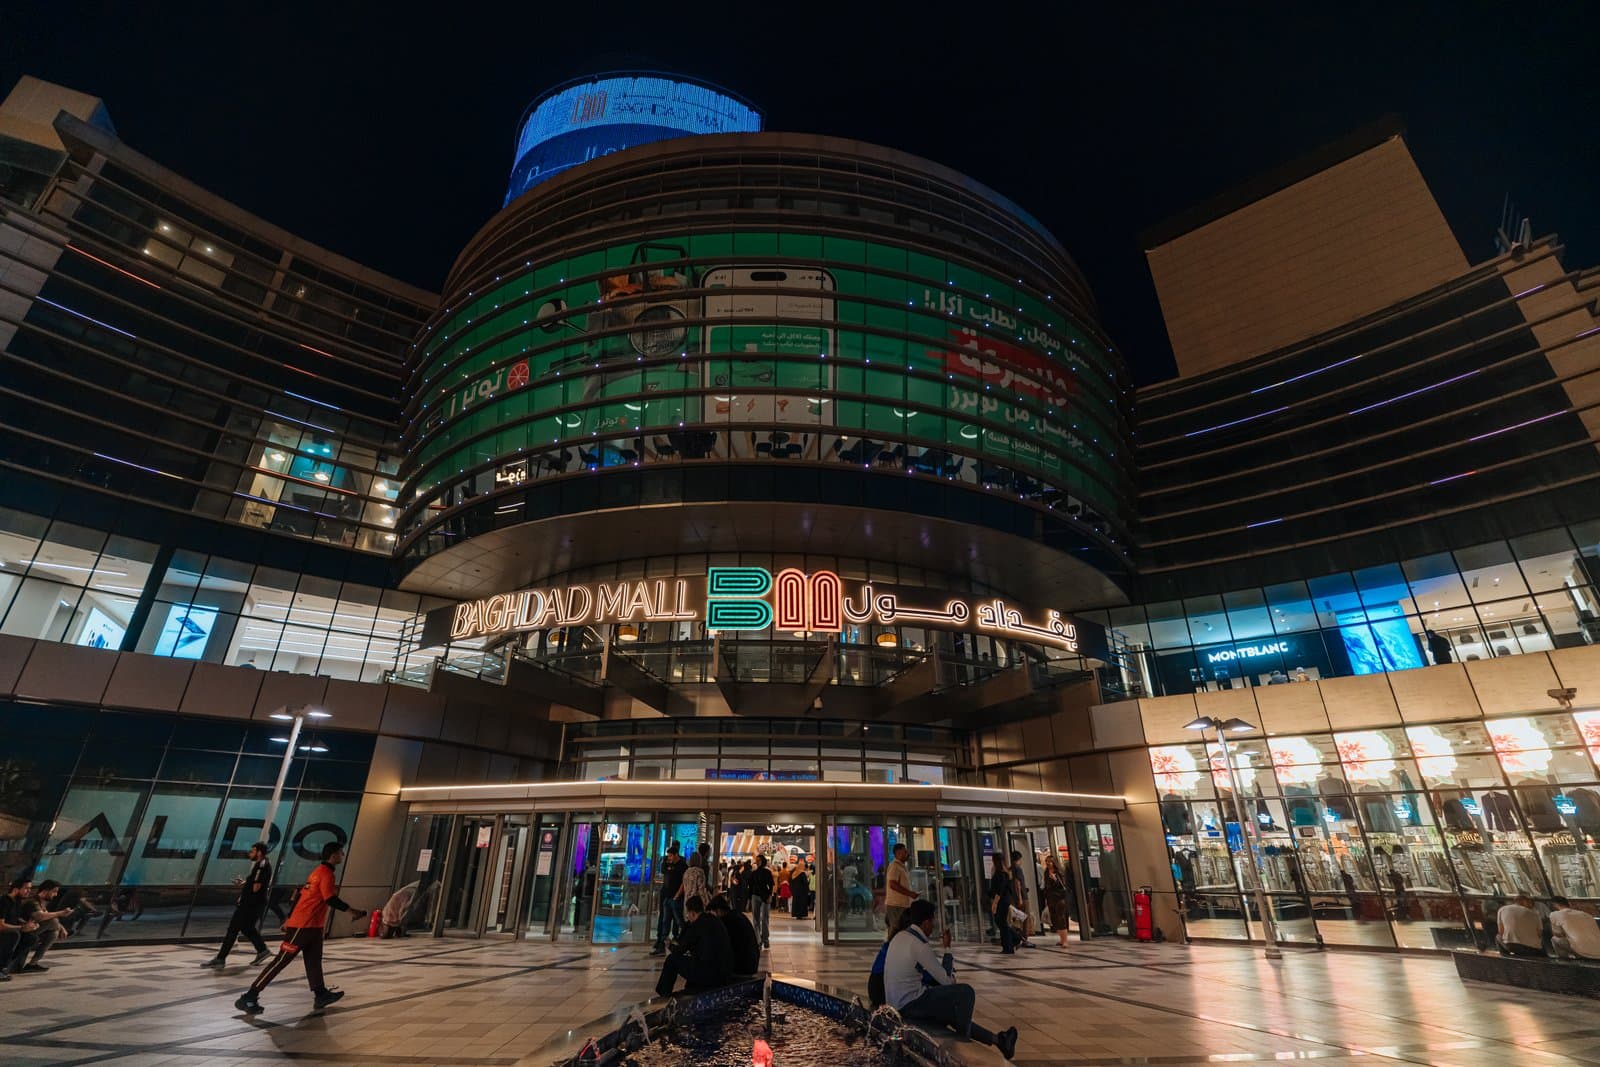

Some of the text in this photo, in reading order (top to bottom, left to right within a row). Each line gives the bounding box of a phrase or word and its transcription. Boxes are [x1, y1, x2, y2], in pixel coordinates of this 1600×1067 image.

[450, 579, 697, 638] BAGHDAD MALL
[843, 585, 1079, 652] بغداد مول
[1207, 641, 1289, 663] MONTBLANC
[46, 811, 349, 861] ALDO
